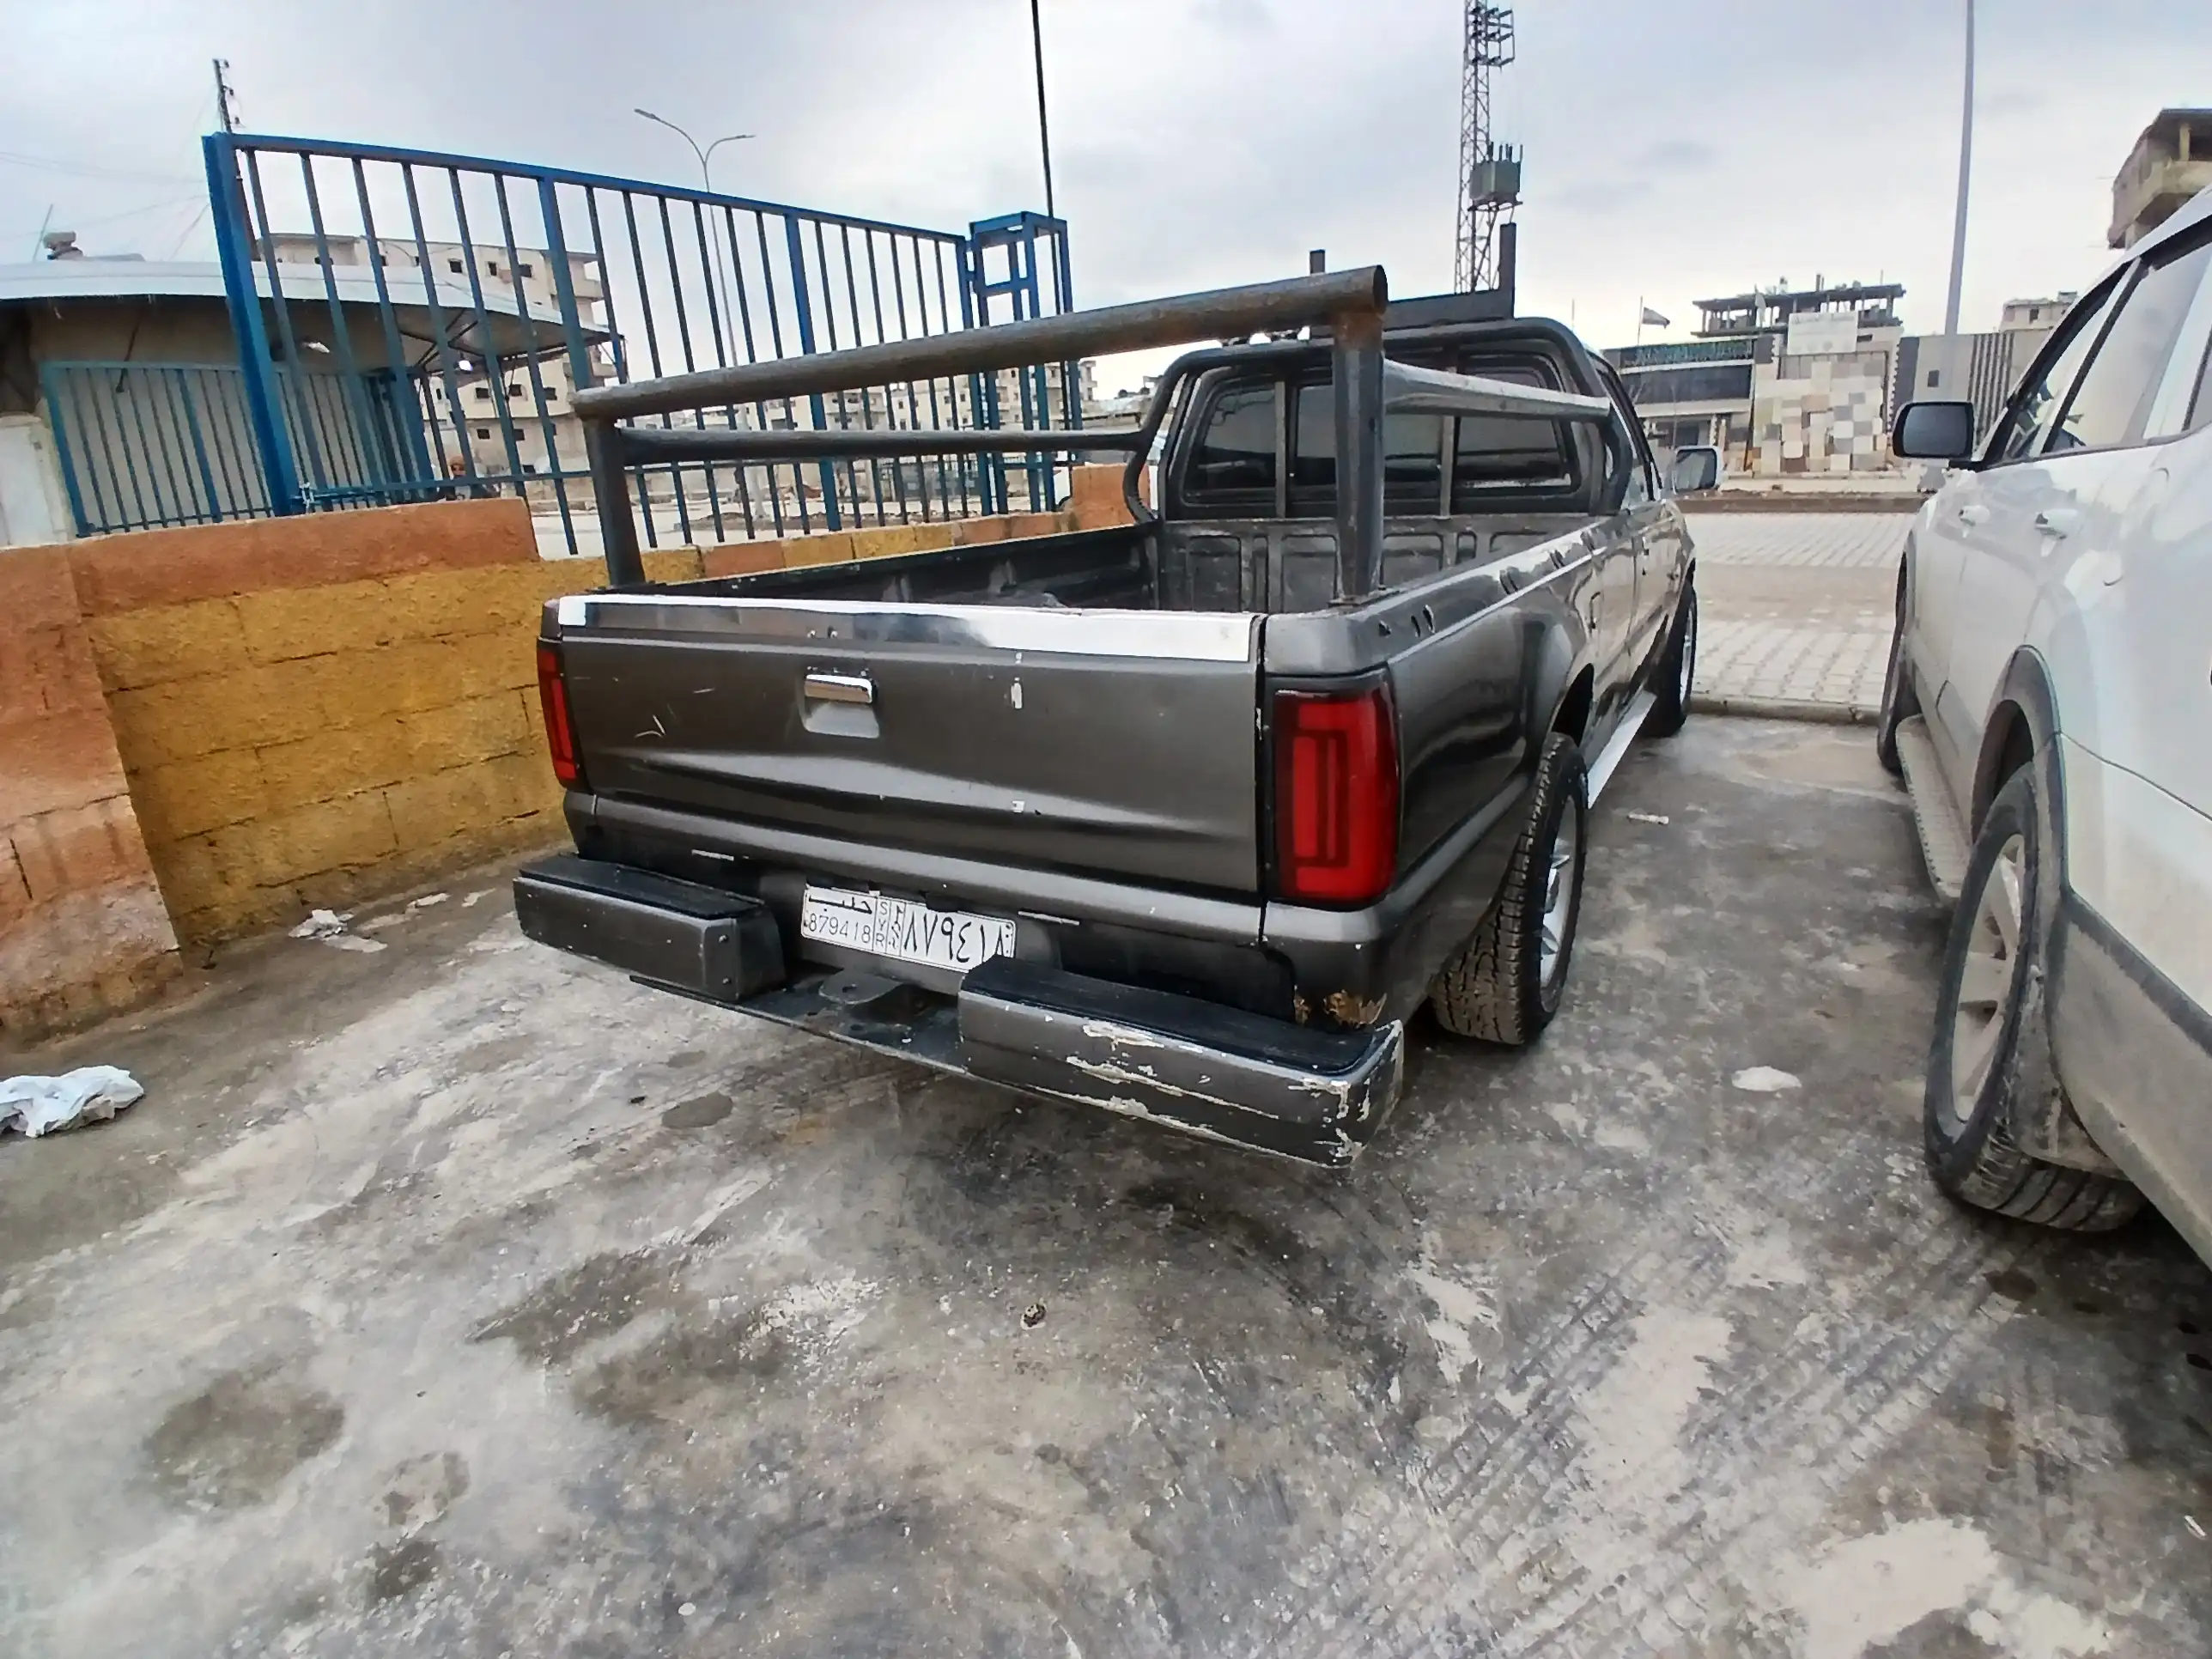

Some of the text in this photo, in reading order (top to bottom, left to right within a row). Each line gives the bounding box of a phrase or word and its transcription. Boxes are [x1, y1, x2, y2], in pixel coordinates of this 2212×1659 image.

[809, 896, 872, 914] حلب
[808, 913, 872, 944] 879418
[875, 902, 888, 946] SYR
[904, 911, 1004, 963] ٨٧٩٤١٨
